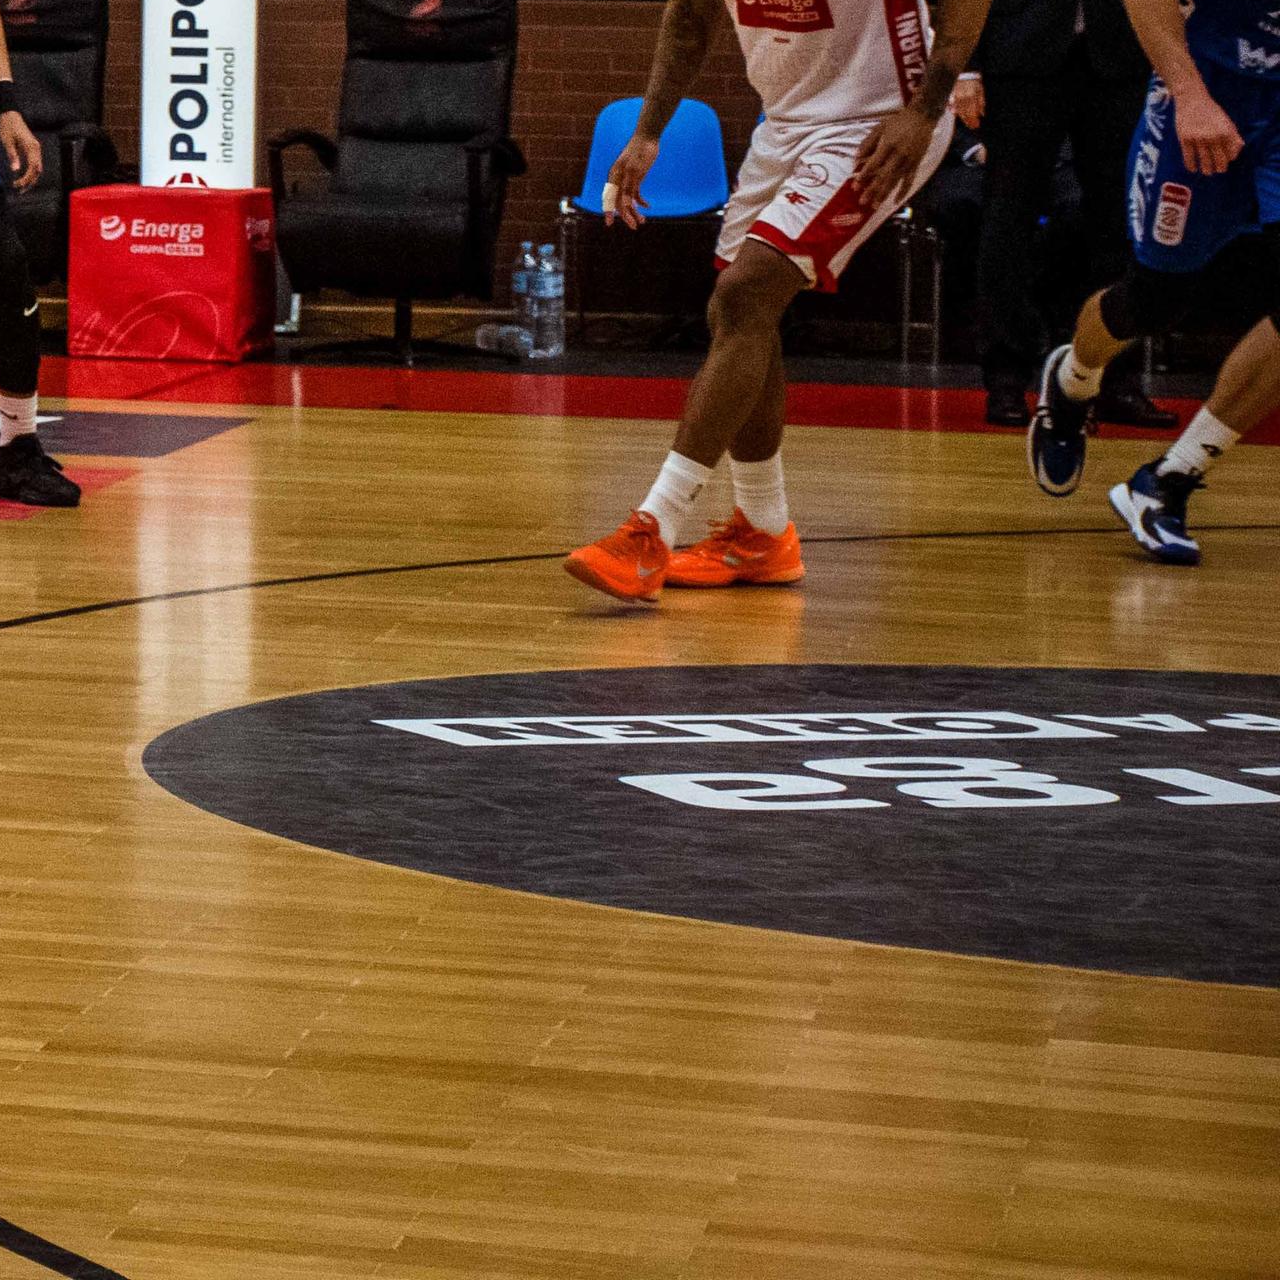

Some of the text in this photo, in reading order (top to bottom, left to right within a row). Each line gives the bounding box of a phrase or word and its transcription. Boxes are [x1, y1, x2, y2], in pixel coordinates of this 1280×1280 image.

[215, 46, 237, 166] international
[130, 218, 204, 243] Energa
[460, 716, 1049, 742] ORLEN
